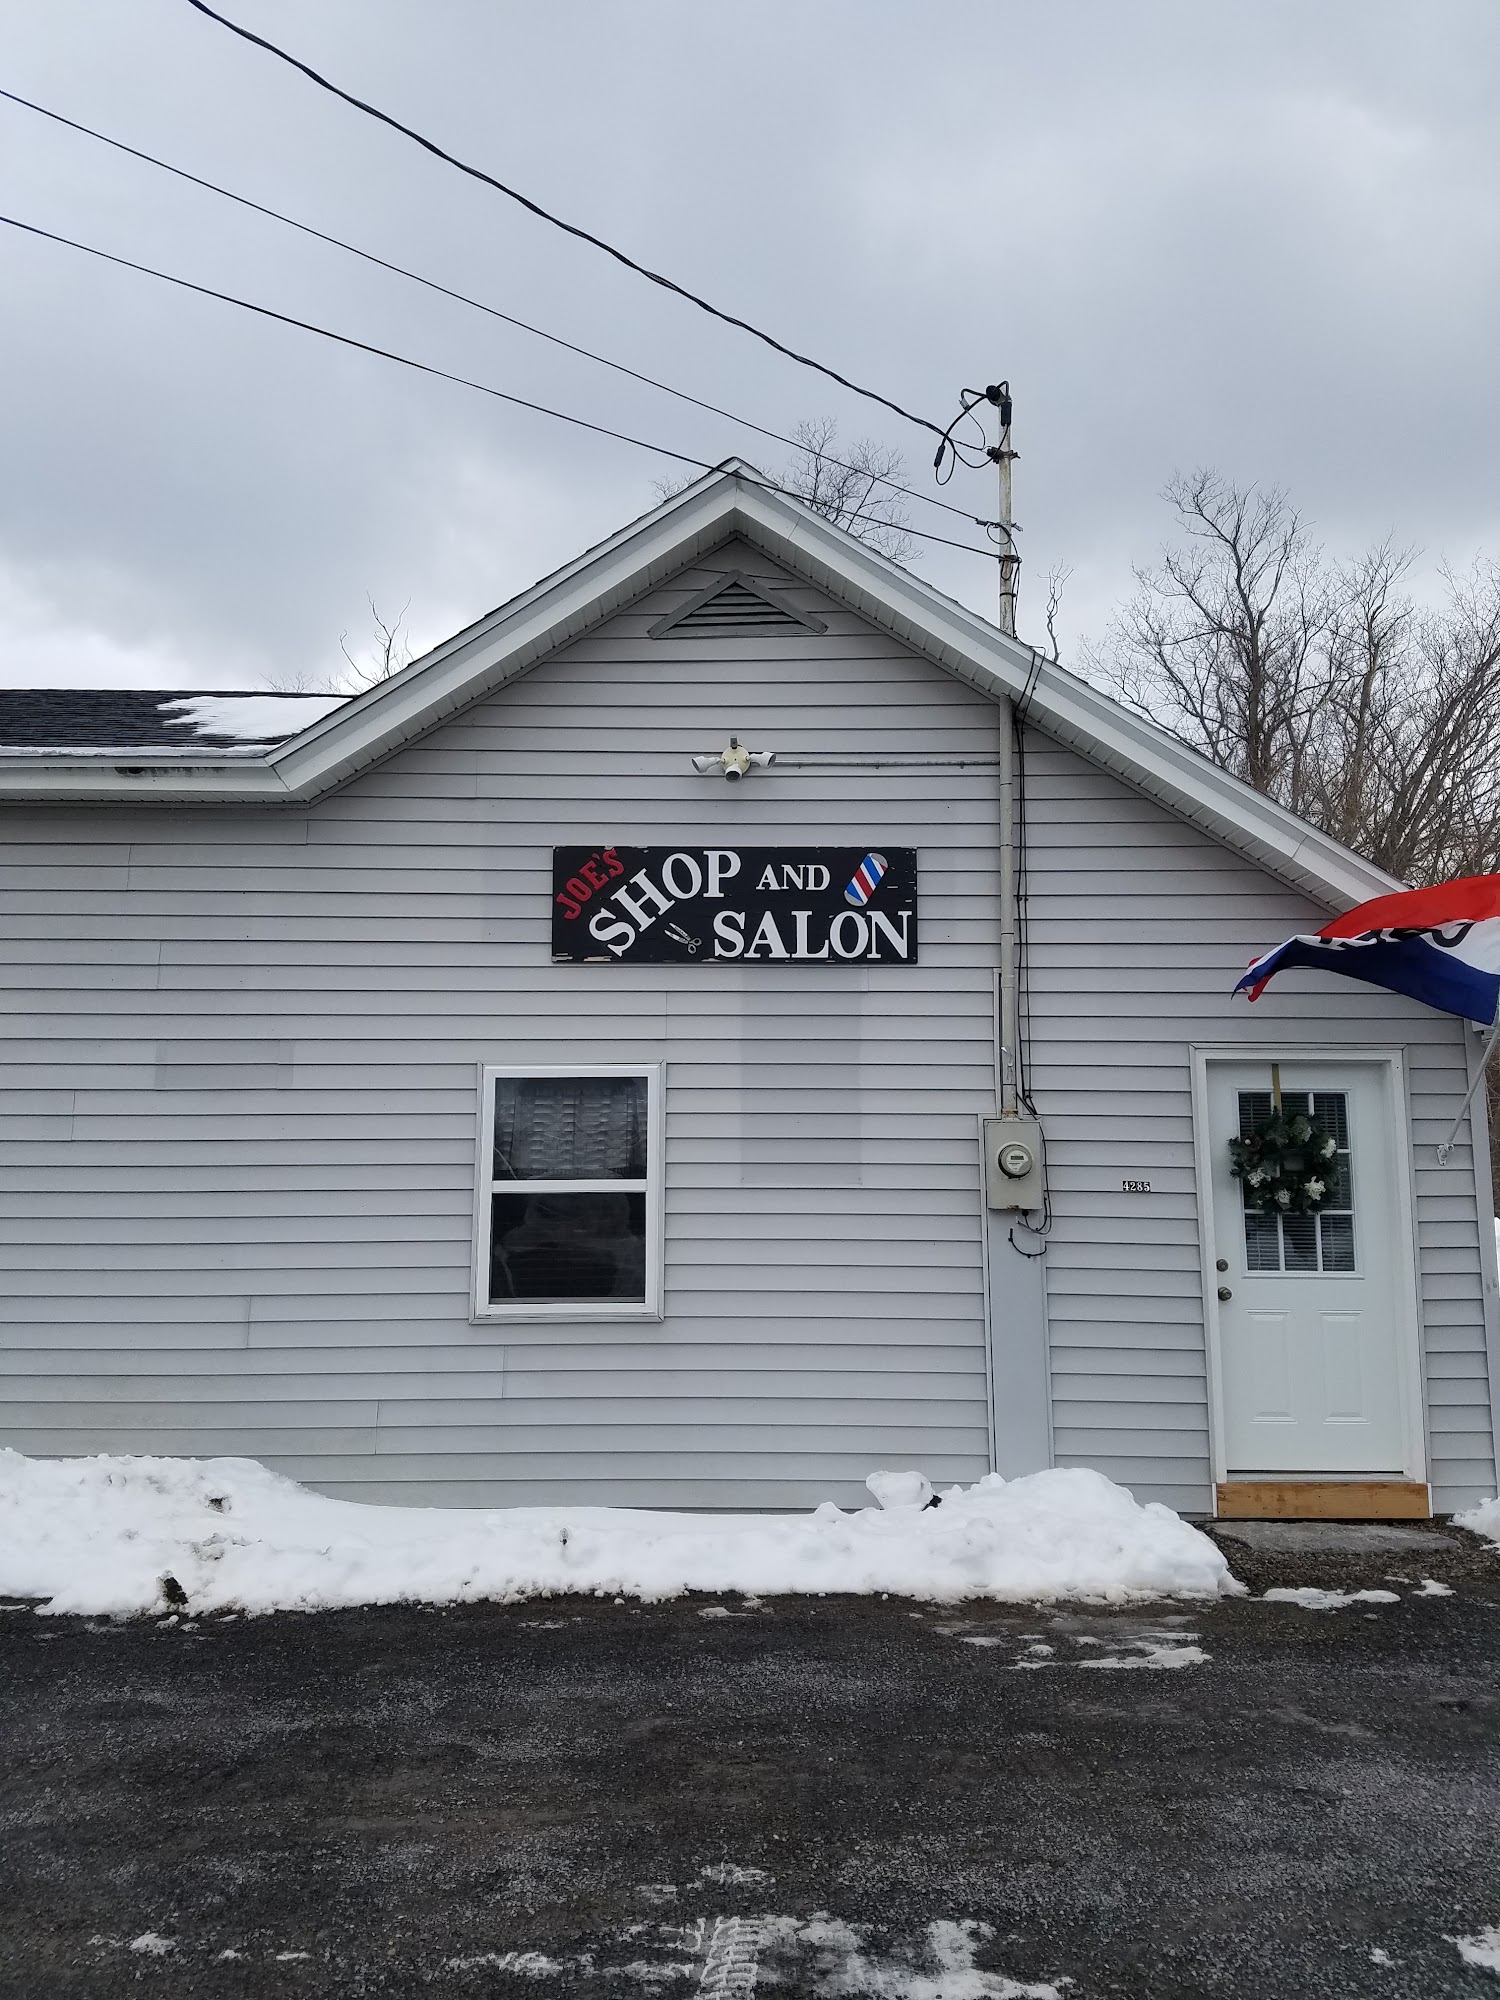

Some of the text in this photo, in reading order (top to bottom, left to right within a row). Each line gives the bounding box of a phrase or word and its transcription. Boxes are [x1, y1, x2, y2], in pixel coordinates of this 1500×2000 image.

[556, 848, 626, 920] JOE'S
[588, 850, 831, 957] SHOP AND
[713, 910, 913, 959] SALON
[1123, 1181, 1150, 1192] 4285
